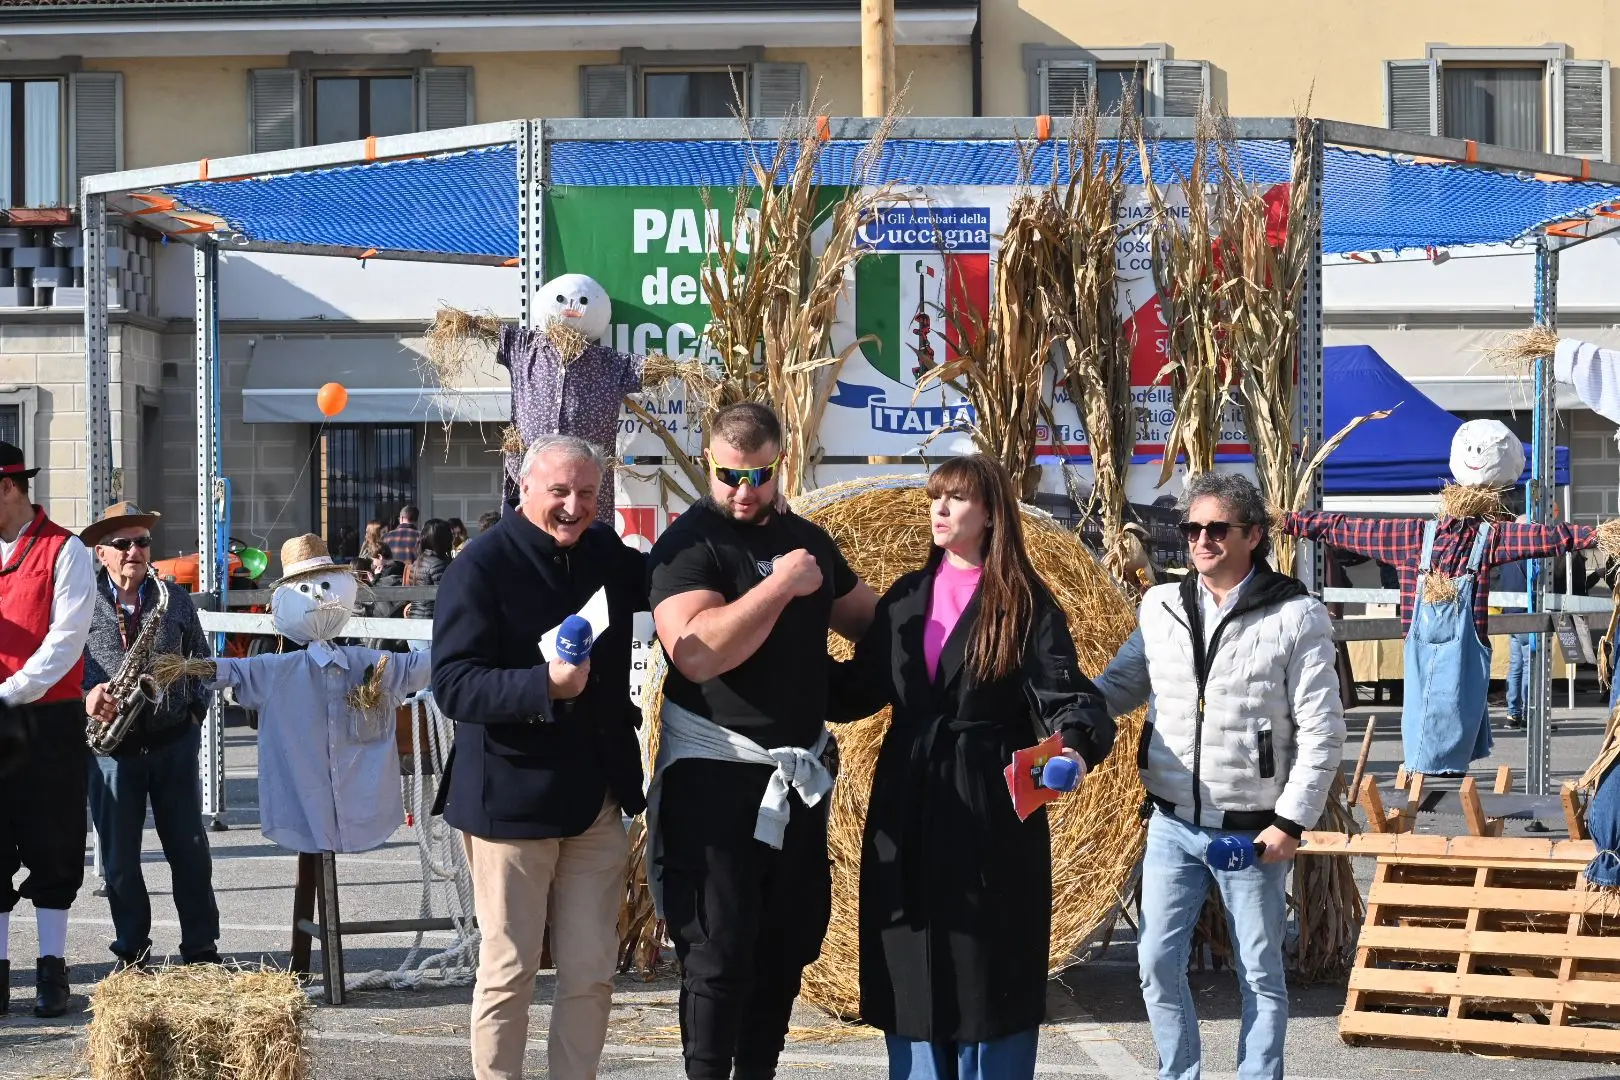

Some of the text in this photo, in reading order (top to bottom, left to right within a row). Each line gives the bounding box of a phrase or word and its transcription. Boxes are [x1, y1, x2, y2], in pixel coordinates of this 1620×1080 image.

[633, 208, 761, 254] PALO
[857, 213, 988, 249] Cuccagna
[887, 213, 987, 224] Gli Acrobati della
[1129, 258, 1152, 270] CO
[874, 406, 972, 431] ITALIA
